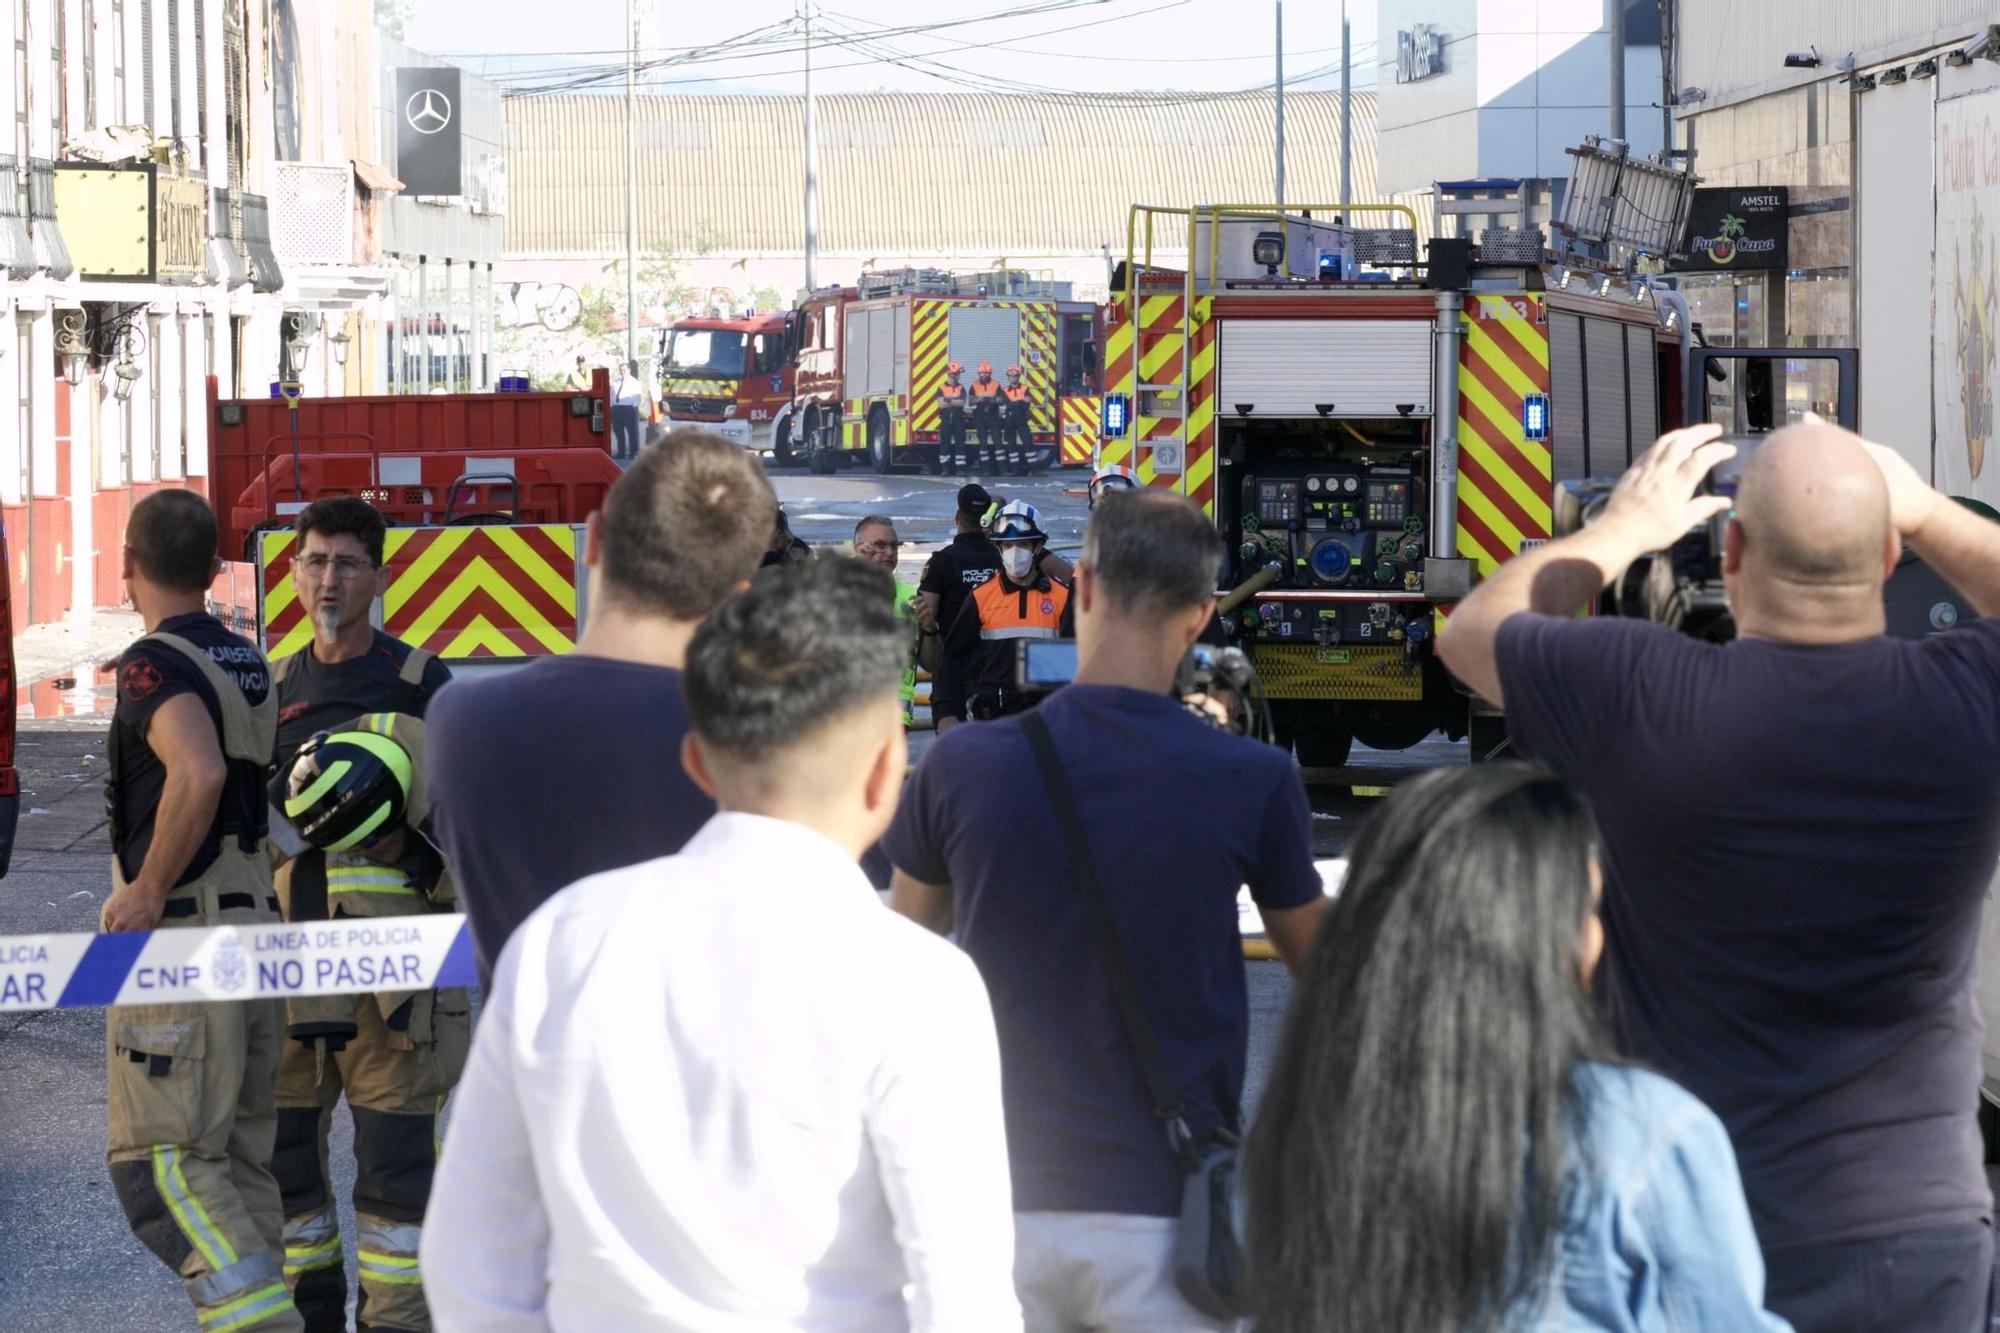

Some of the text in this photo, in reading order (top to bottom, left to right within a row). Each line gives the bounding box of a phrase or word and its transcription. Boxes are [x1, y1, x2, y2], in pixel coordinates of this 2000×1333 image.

[1983, 111, 2000, 187] Ca
[1741, 196, 1780, 207] AMSTEL
[1736, 237, 1775, 251] Cana
[750, 409, 768, 420] B34
[1419, 405, 1425, 414] 7
[1362, 624, 1371, 635] 2
[255, 926, 423, 951] LINEA DE POLICIA
[138, 966, 200, 989] CNP
[258, 954, 423, 991] NO PASAR
[2, 972, 46, 1004] AR
